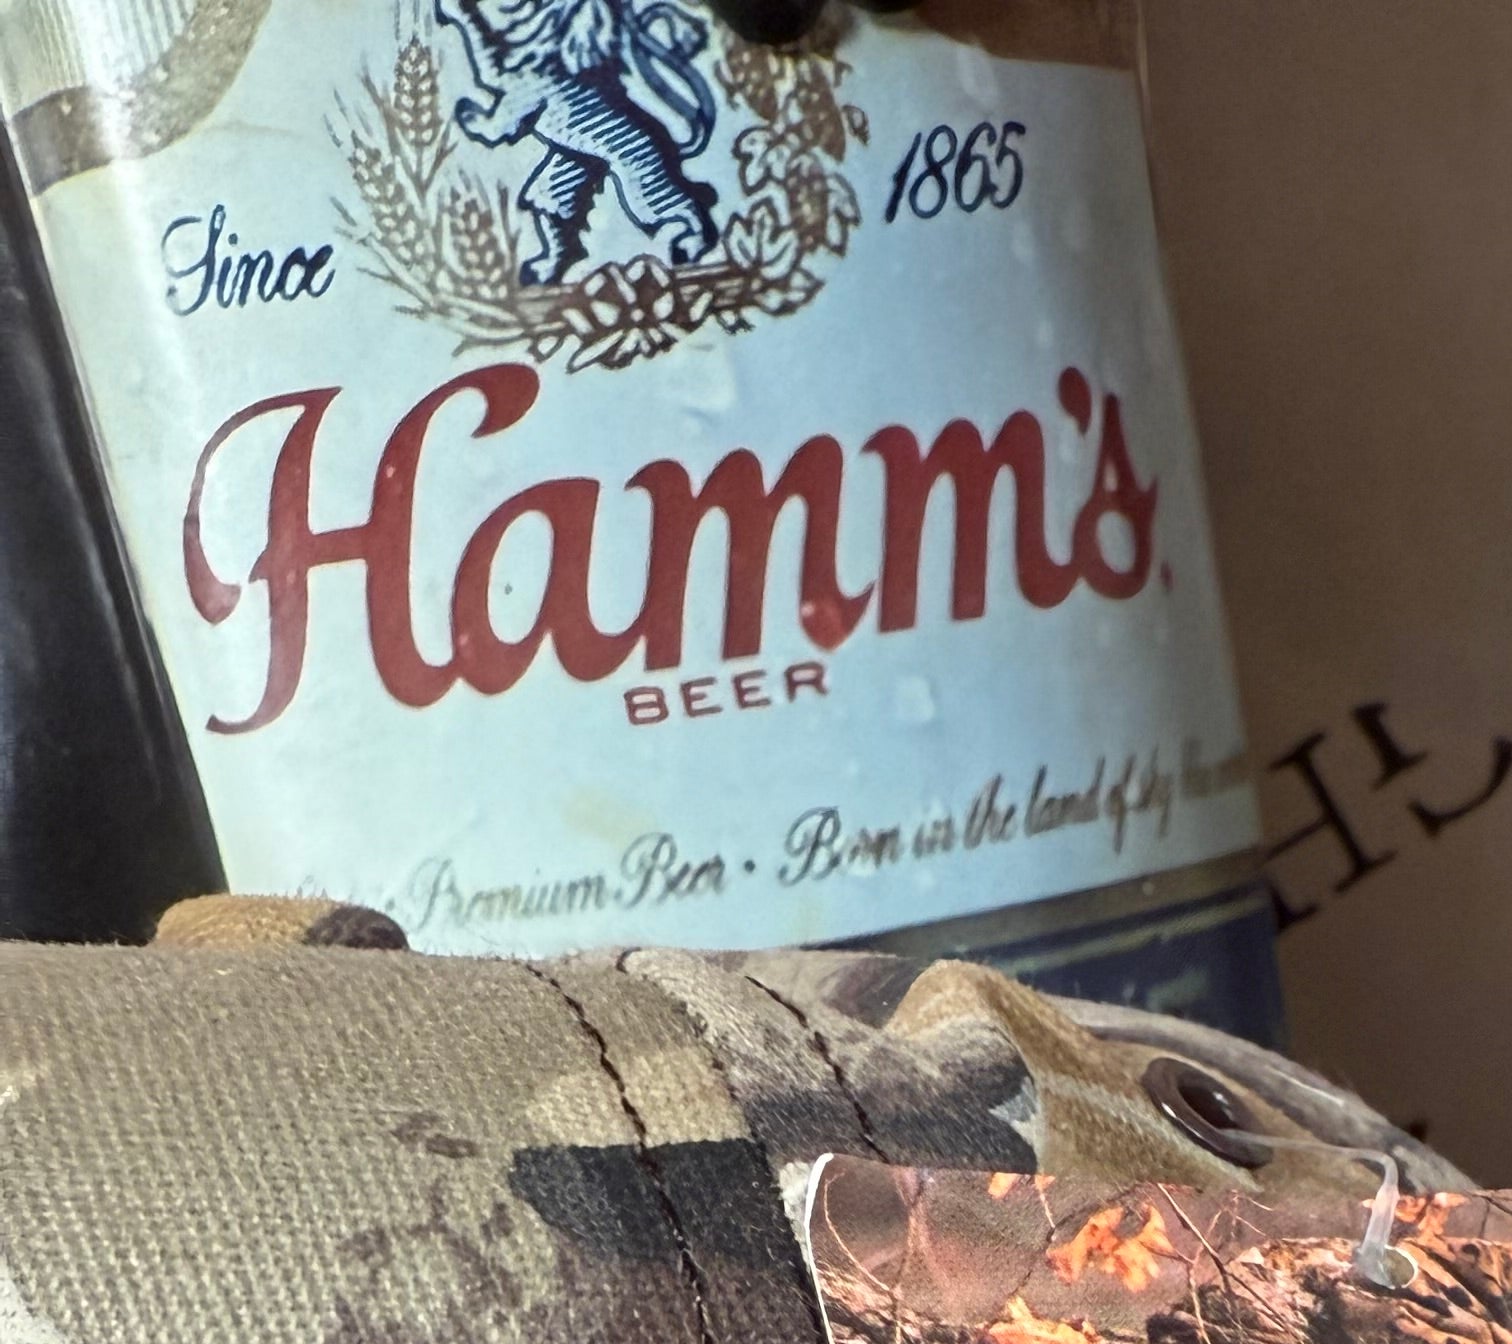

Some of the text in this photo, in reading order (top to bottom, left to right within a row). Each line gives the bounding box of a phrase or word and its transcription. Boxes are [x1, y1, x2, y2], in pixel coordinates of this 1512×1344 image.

[164, 120, 1027, 317] Since 1865
[183, 361, 1160, 734] Hamm's
[623, 661, 831, 727] BEER
[409, 856, 606, 930] Premium
[614, 831, 727, 910] Beer
[777, 804, 901, 886] Born
[963, 773, 1018, 850] the
